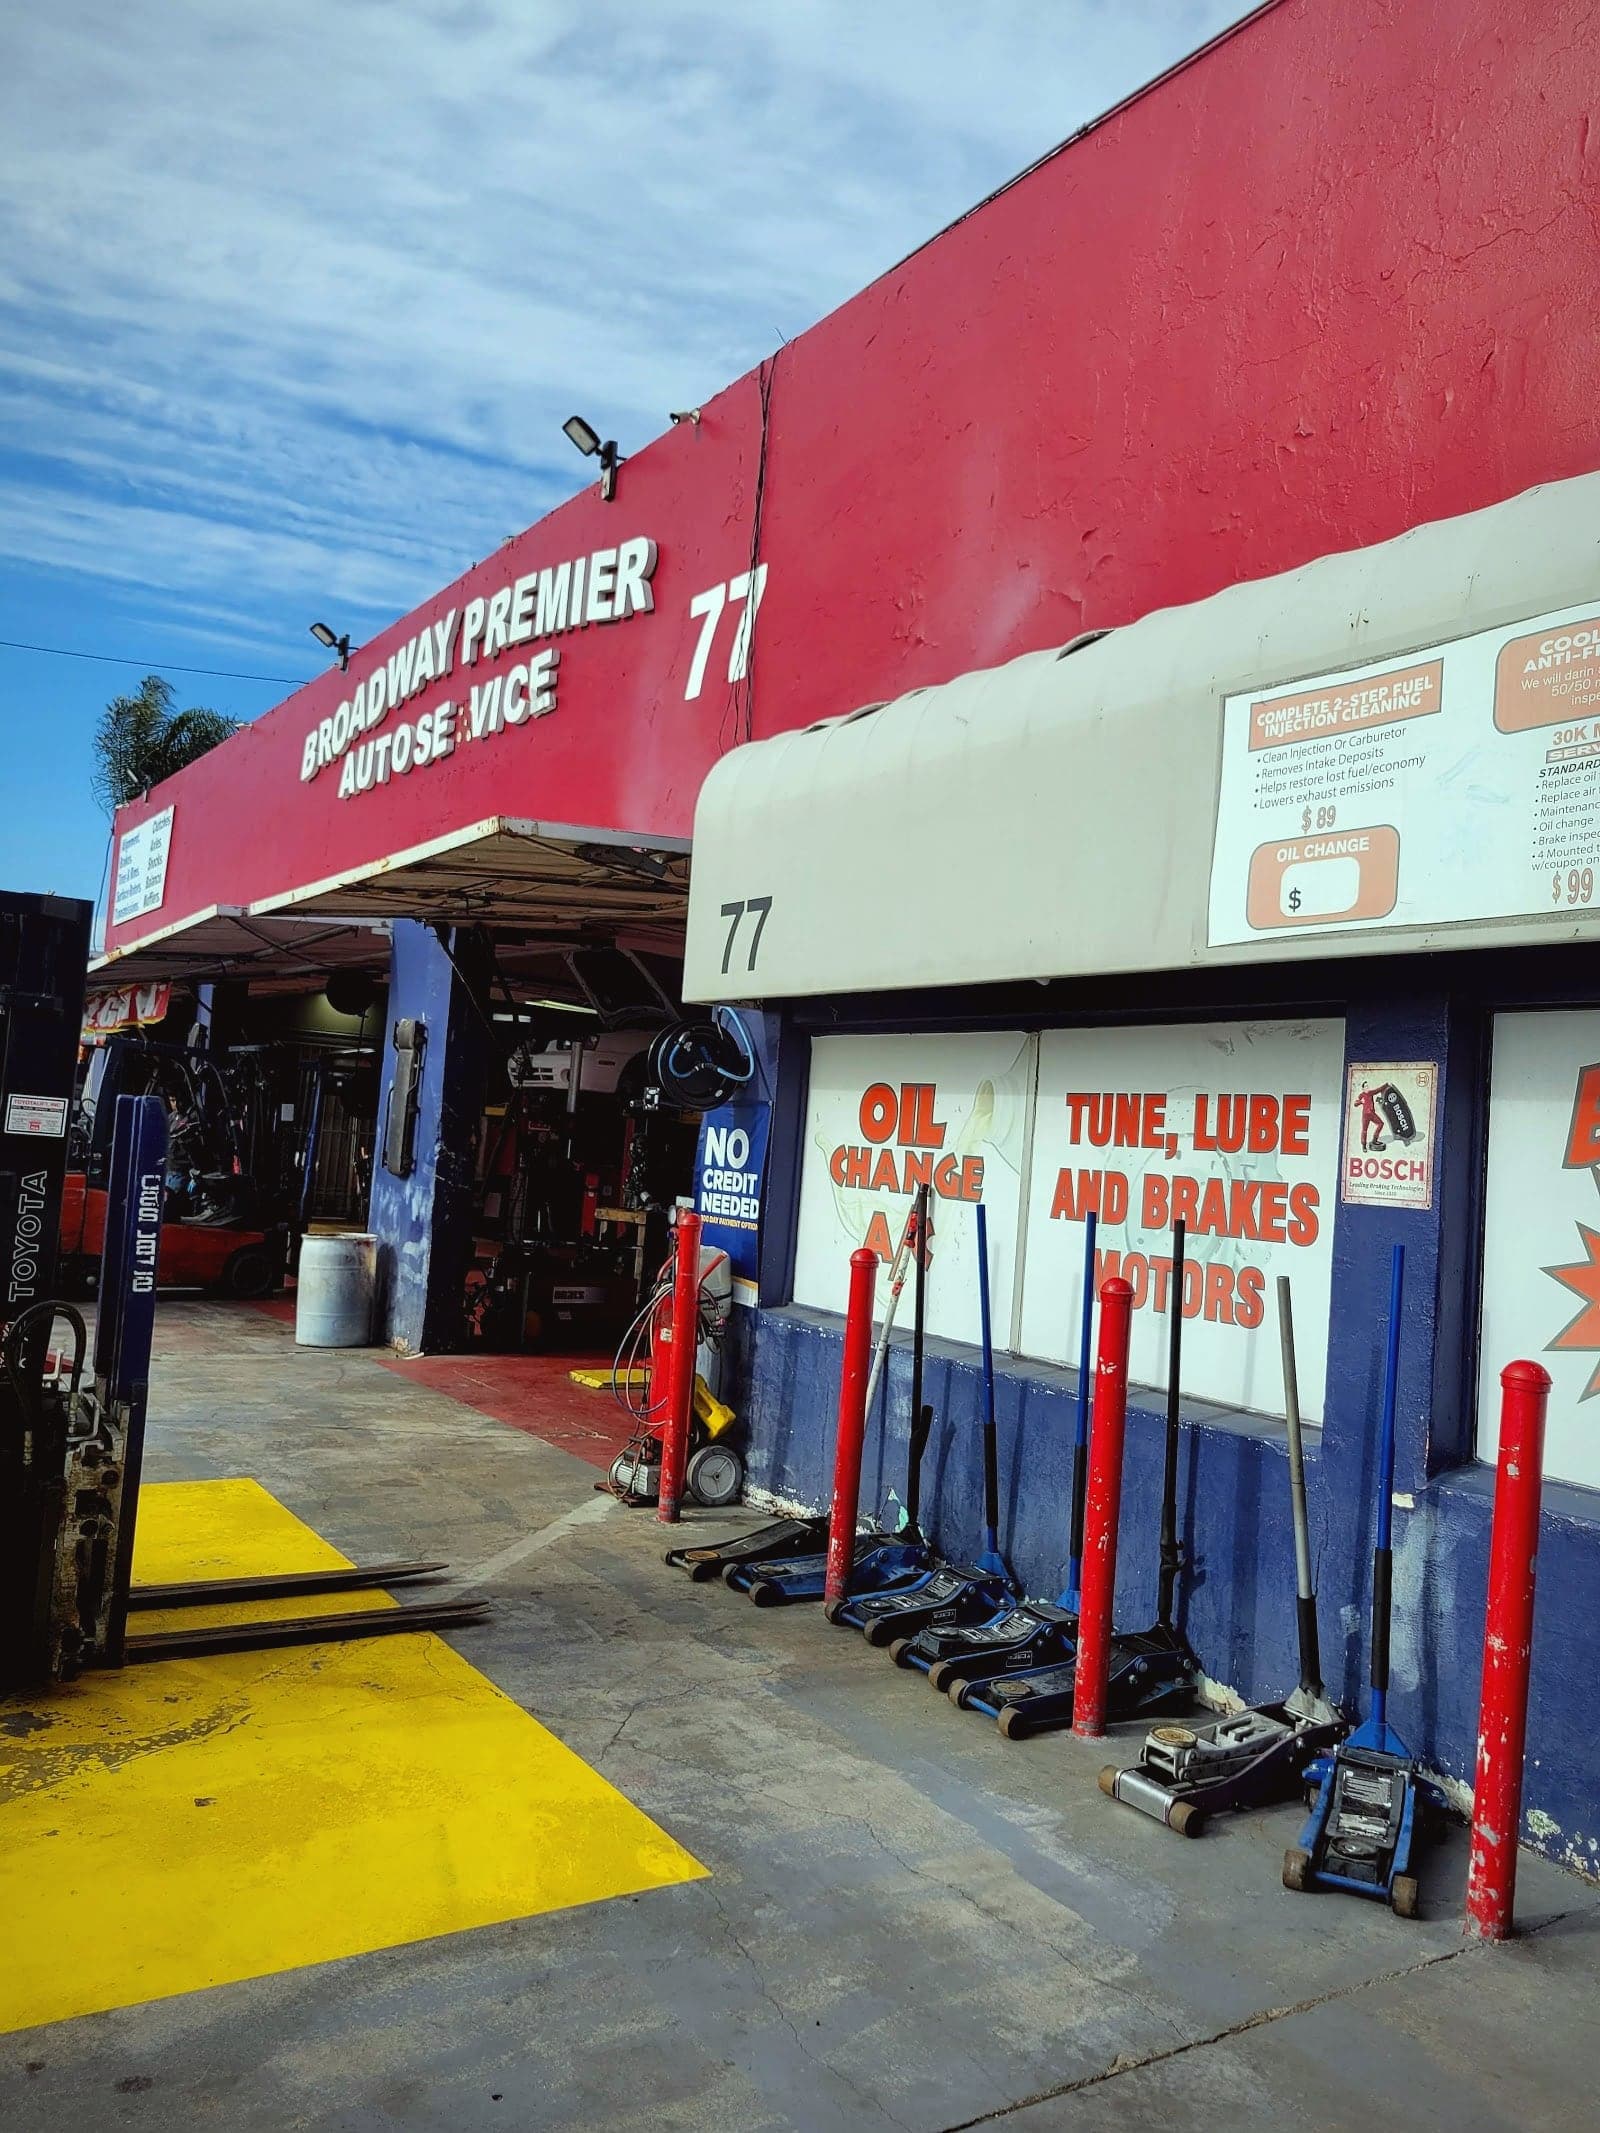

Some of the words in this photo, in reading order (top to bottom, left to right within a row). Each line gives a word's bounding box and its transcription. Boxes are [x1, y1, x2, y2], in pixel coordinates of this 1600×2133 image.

[685, 563, 768, 701] 77
[300, 608, 461, 782] BROADWAY
[462, 536, 657, 665] PREMIER
[1520, 679, 1540, 691] We
[1542, 673, 1561, 685] will
[1551, 679, 1591, 697] 50/50
[1256, 699, 1330, 727] COMPLETE
[1333, 686, 1389, 711] 2-STEP
[1392, 675, 1434, 696] FUEL
[1264, 710, 1338, 738] INJECTION
[1342, 692, 1422, 722] CLEANING
[1262, 751, 1288, 765] Clean
[1290, 742, 1332, 761] Injection
[1334, 739, 1347, 751] Or
[1349, 727, 1407, 748] Carburetor
[1552, 725, 1588, 746] 30K
[338, 724, 415, 799] AUTO
[1260, 780, 1287, 796] Helps
[1289, 774, 1324, 790] restore
[1326, 769, 1345, 783] lost
[1348, 755, 1426, 779] fuel/economy
[1261, 764, 1303, 779] Removes
[1305, 755, 1336, 771] Intake
[1338, 748, 1384, 768] Deposits
[1259, 795, 1294, 810] Lowers
[1296, 787, 1337, 804] exhaust
[1339, 776, 1395, 796] emissions
[1541, 776, 1581, 791] Replace
[1584, 772, 1597, 782] oil
[1541, 790, 1581, 805] Replace
[1583, 787, 1596, 798] air
[1302, 805, 1312, 834] $
[1316, 805, 1336, 829] 89
[1539, 821, 1553, 832] Oil
[1555, 816, 1594, 831] change
[1276, 848, 1300, 863] OIL
[1304, 836, 1370, 859] CHANGE
[1537, 850, 1544, 859] 4
[1546, 843, 1594, 859] Mounted
[1538, 834, 1567, 846] Brake
[1531, 858, 1583, 872] w/coupon
[1288, 887, 1302, 912] $
[1552, 870, 1562, 904] $
[1567, 867, 1594, 905] 99
[721, 896, 773, 974] 77
[858, 1082, 948, 1150] OIL
[1065, 1092, 1178, 1160] TUNE,
[1192, 1093, 1312, 1156] LUBE
[1393, 1103, 1409, 1132] BOSCH
[704, 1127, 749, 1169] NO
[702, 1168, 758, 1195] CREDIT
[829, 1144, 985, 1203] CHANGE
[1349, 1157, 1425, 1181] BOSCH
[700, 1191, 759, 1220] NEEDED
[1050, 1167, 1129, 1225] AND
[1141, 1173, 1320, 1247] BRAKES
[8, 1170, 48, 1302] TOYOTA
[1095, 1247, 1266, 1330] MOTORS
